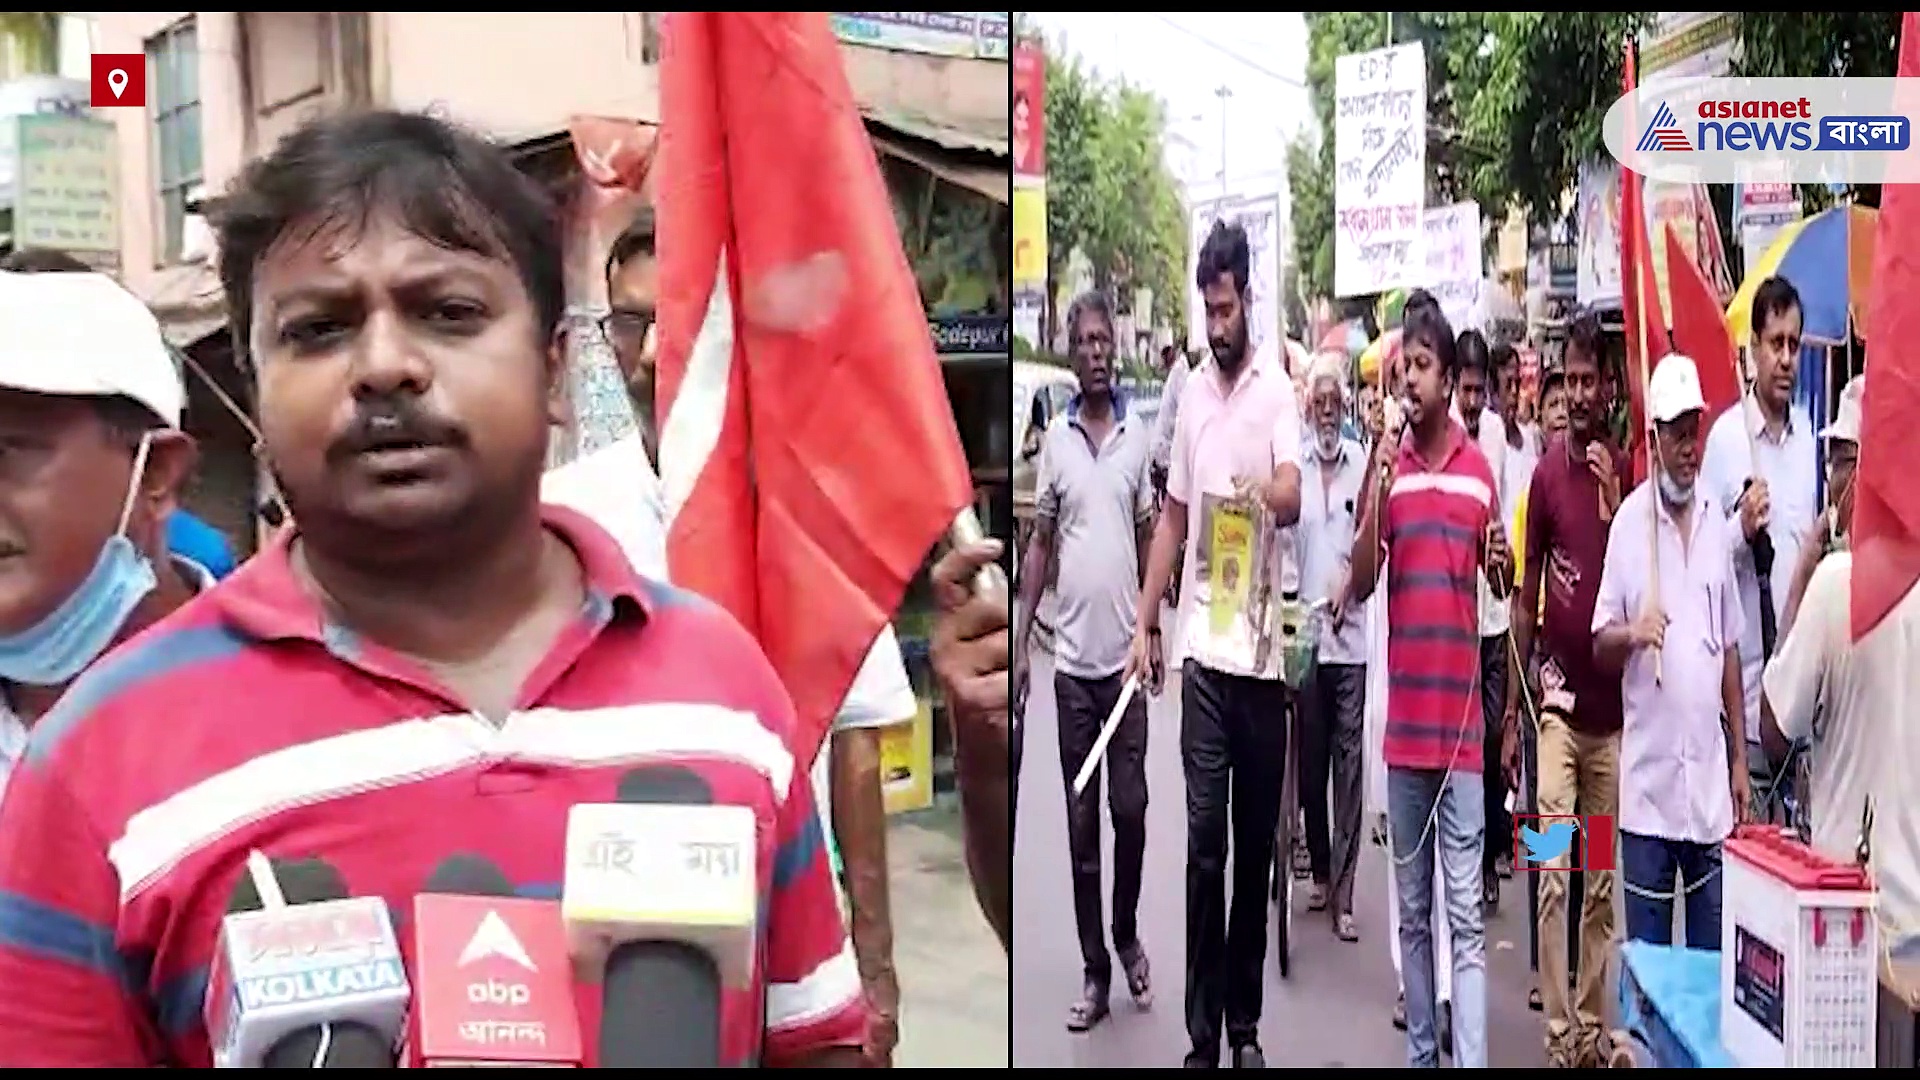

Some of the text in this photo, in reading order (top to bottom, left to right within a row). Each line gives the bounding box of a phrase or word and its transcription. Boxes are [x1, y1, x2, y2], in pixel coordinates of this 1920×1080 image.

[582, 830, 637, 876] এই
[243, 960, 400, 1008] KOLKATA
[466, 977, 531, 1006] abp
[458, 1019, 547, 1047] আনন্দ
